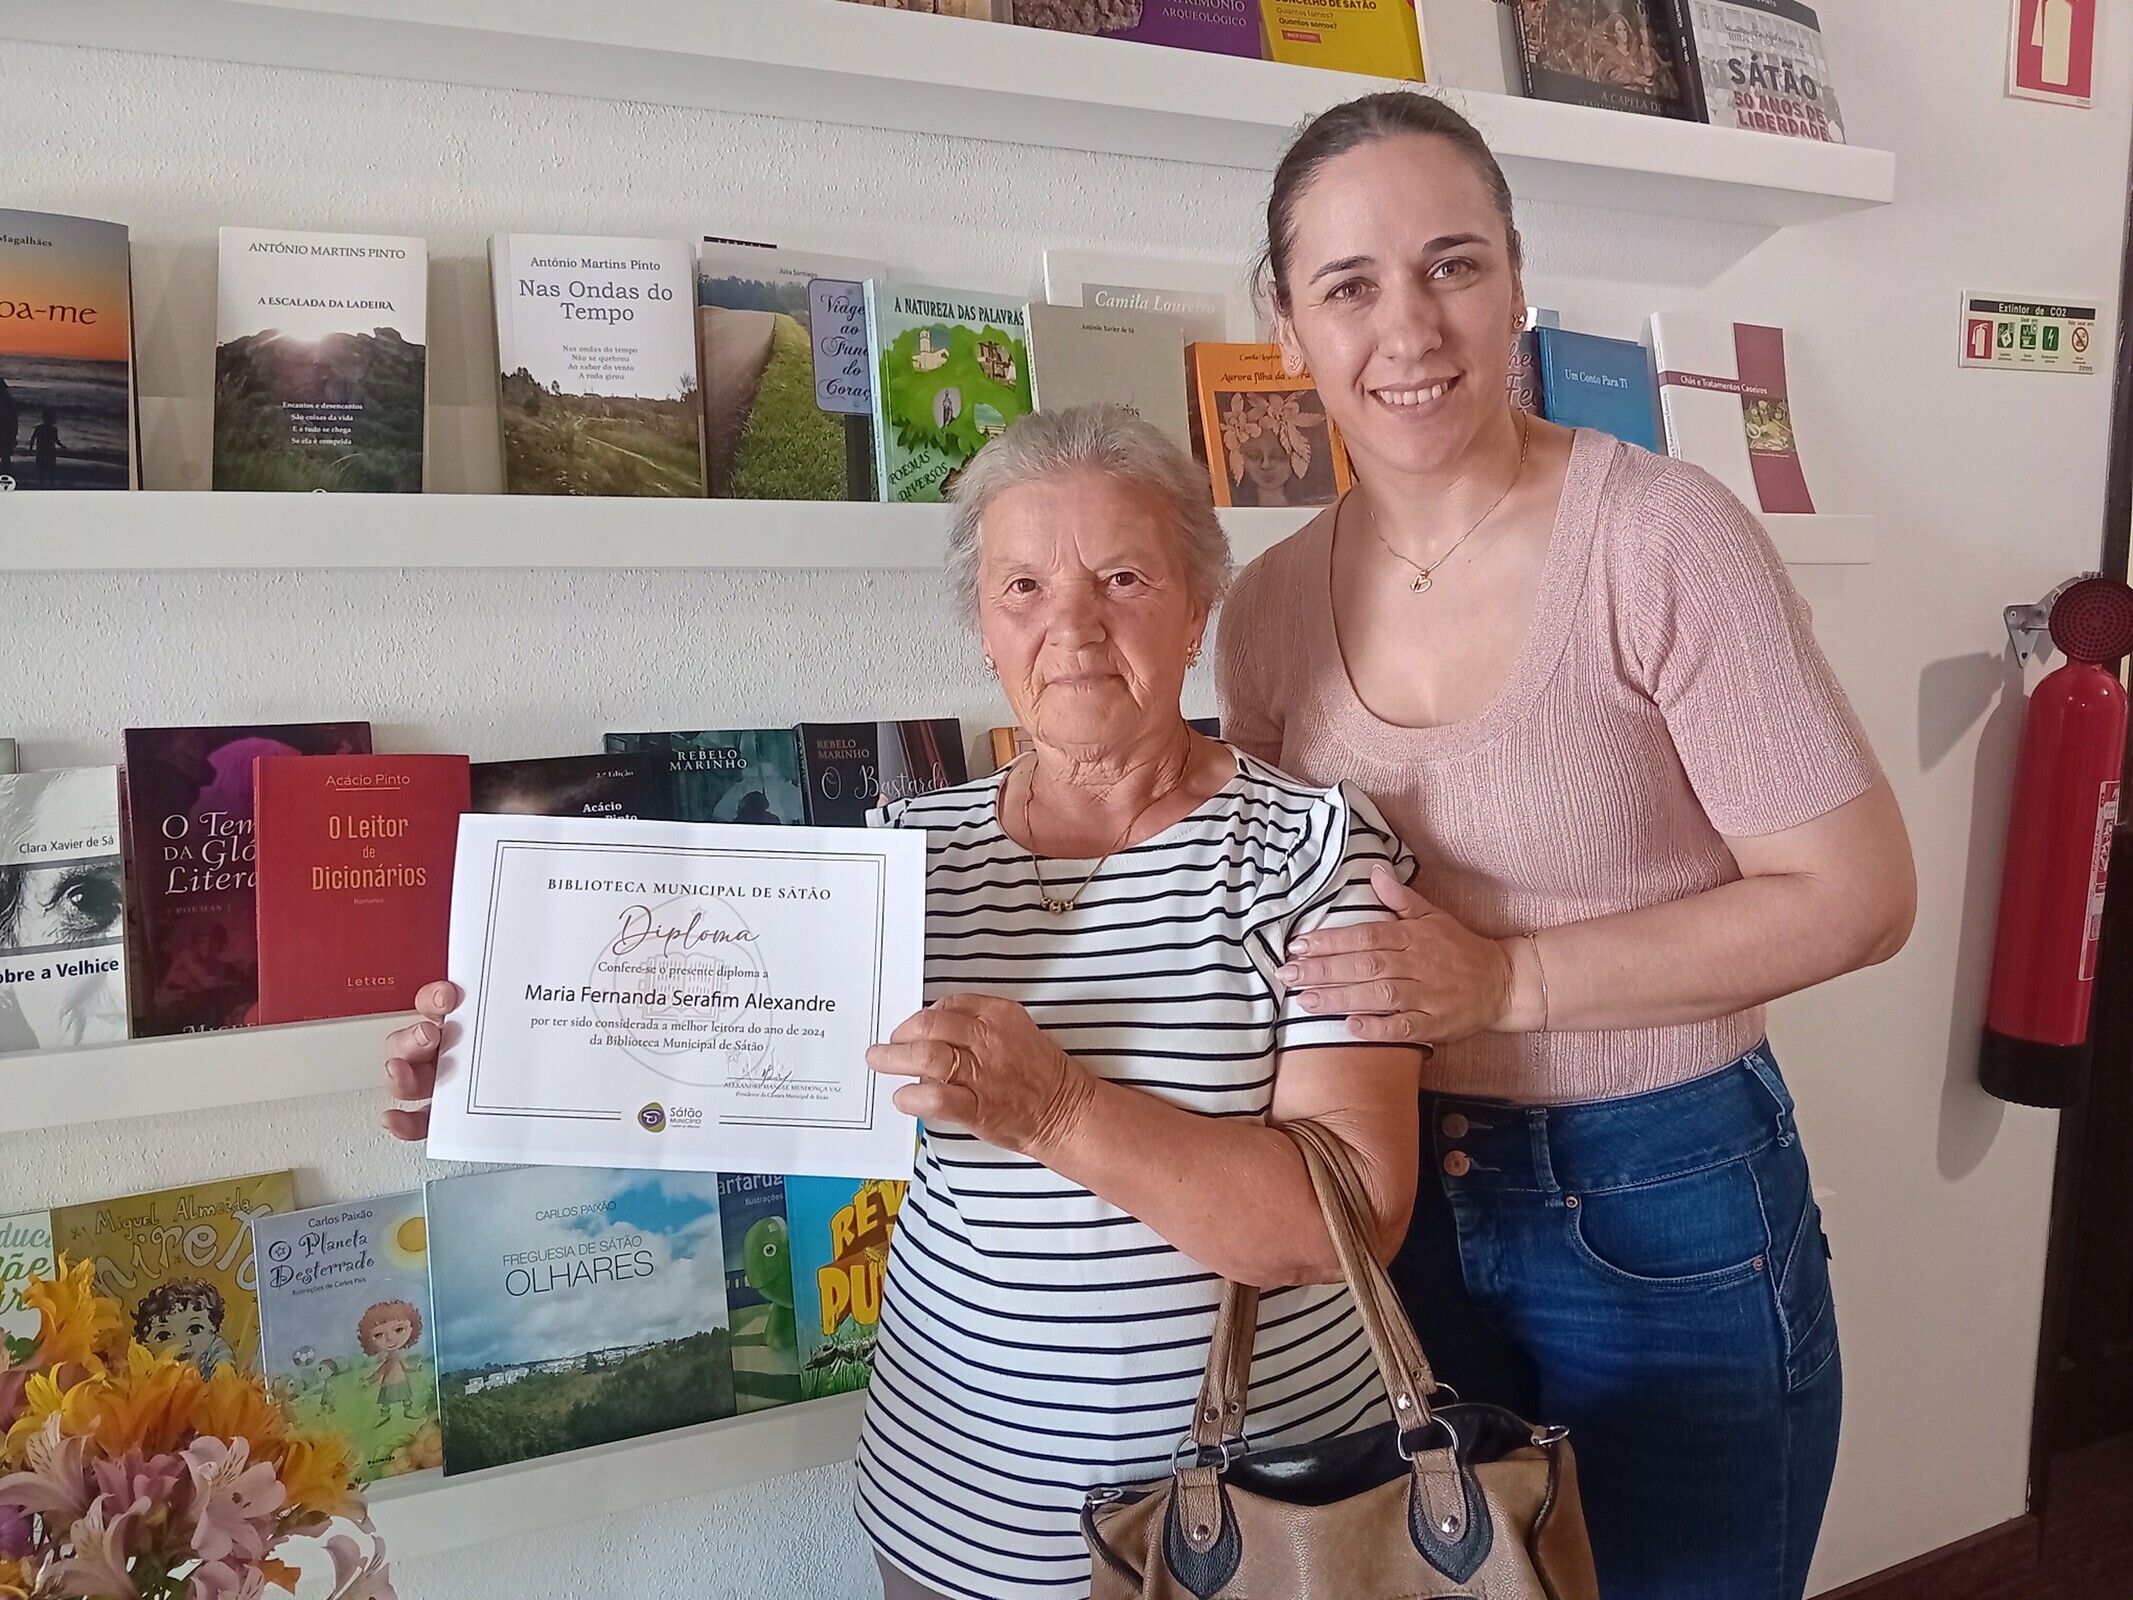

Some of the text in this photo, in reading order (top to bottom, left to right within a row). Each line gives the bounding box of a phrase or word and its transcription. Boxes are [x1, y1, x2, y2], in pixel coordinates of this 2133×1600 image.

[1161, 7, 1247, 27] ARQUEOLÓGICO
[1278, 17, 1338, 30] Quantos somos?
[1727, 53, 1818, 101] SÁTÃO
[1610, 93, 1648, 110] CAPELA
[1733, 90, 1827, 127] 50 ANOS DE
[1737, 109, 1830, 142] LIBERDADE
[248, 242, 406, 260] ANTÓNIO MARTINS PINTO
[530, 257, 661, 271] António Martins Pinto
[518, 279, 673, 301] Nas Ondas do
[258, 296, 396, 312] A ESCALADA DA LADEIRA
[894, 296, 1024, 326] A NATUREZA DAS PALAVRAS
[1095, 290, 1215, 315] Camila Loureiro
[1998, 302, 2067, 318] Extintor de CO2
[560, 302, 635, 326] Tempo
[840, 325, 860, 335] ao
[571, 354, 587, 362] Não
[598, 355, 630, 364] quebrou
[578, 345, 602, 353] ondas
[603, 346, 613, 354] do
[614, 347, 638, 355] tempo
[578, 372, 625, 382] A roda girou
[842, 359, 864, 377] do
[1220, 372, 1252, 384] Aurora
[1274, 371, 1286, 380] da
[1564, 368, 1629, 389] Um Conto Para Ti
[1680, 375, 1768, 395] Chás Tratamentos Caseiros
[282, 401, 364, 410] Encantos desencantos
[304, 425, 321, 433] tudo
[331, 426, 352, 434] chega
[318, 438, 352, 447] comprida
[888, 450, 931, 485] POEMAS
[897, 461, 948, 501] DIVERSOS
[816, 739, 857, 749] REBELO
[669, 758, 748, 771] MARINHO
[678, 749, 738, 761] REBELO
[818, 749, 870, 760] MARINHO
[325, 773, 411, 786] Acácio Pinto
[608, 770, 634, 778] Edição
[821, 761, 951, 801] O Bastardo
[581, 802, 623, 813] Acácio
[162, 814, 189, 840] O
[329, 814, 409, 840] O Leitor
[19, 834, 114, 854] Clara Xavier de Sá
[163, 845, 194, 861] DA
[362, 845, 376, 859] de
[312, 863, 427, 891] Dicionários
[548, 878, 831, 901] BIBLIOTECA MUNICIPAL DE SÁTÃO
[612, 904, 760, 959] Diploma
[0, 958, 120, 984] bre a Velhice
[598, 960, 769, 981] Confere-se o presente diploma a
[525, 984, 836, 1012] Maria Fernanda Serafim Alexandre
[530, 1017, 550, 1029] por
[552, 1018, 568, 1027] ter
[570, 1015, 593, 1028] sido
[594, 1017, 659, 1030] considerada
[671, 1019, 708, 1032] melhor
[711, 1021, 745, 1033] leitora
[747, 1022, 762, 1034] do
[764, 1026, 784, 1035] ano
[786, 1024, 800, 1035] de
[802, 1028, 826, 1039] 2024
[589, 1034, 764, 1052] da Biblioteca Municipal de Sátão
[669, 1106, 703, 1118] Sátão
[95, 1187, 253, 1241] Miguel Almeida
[308, 1209, 373, 1229] Carlos Paixão
[535, 1200, 617, 1221] CARLOS PAIXÃO
[298, 1229, 368, 1259] Planeta
[502, 1234, 643, 1267] FREGUESIA DE SÁTÃO
[269, 1249, 375, 1290] Desterrado
[505, 1250, 654, 1297] OLHARES
